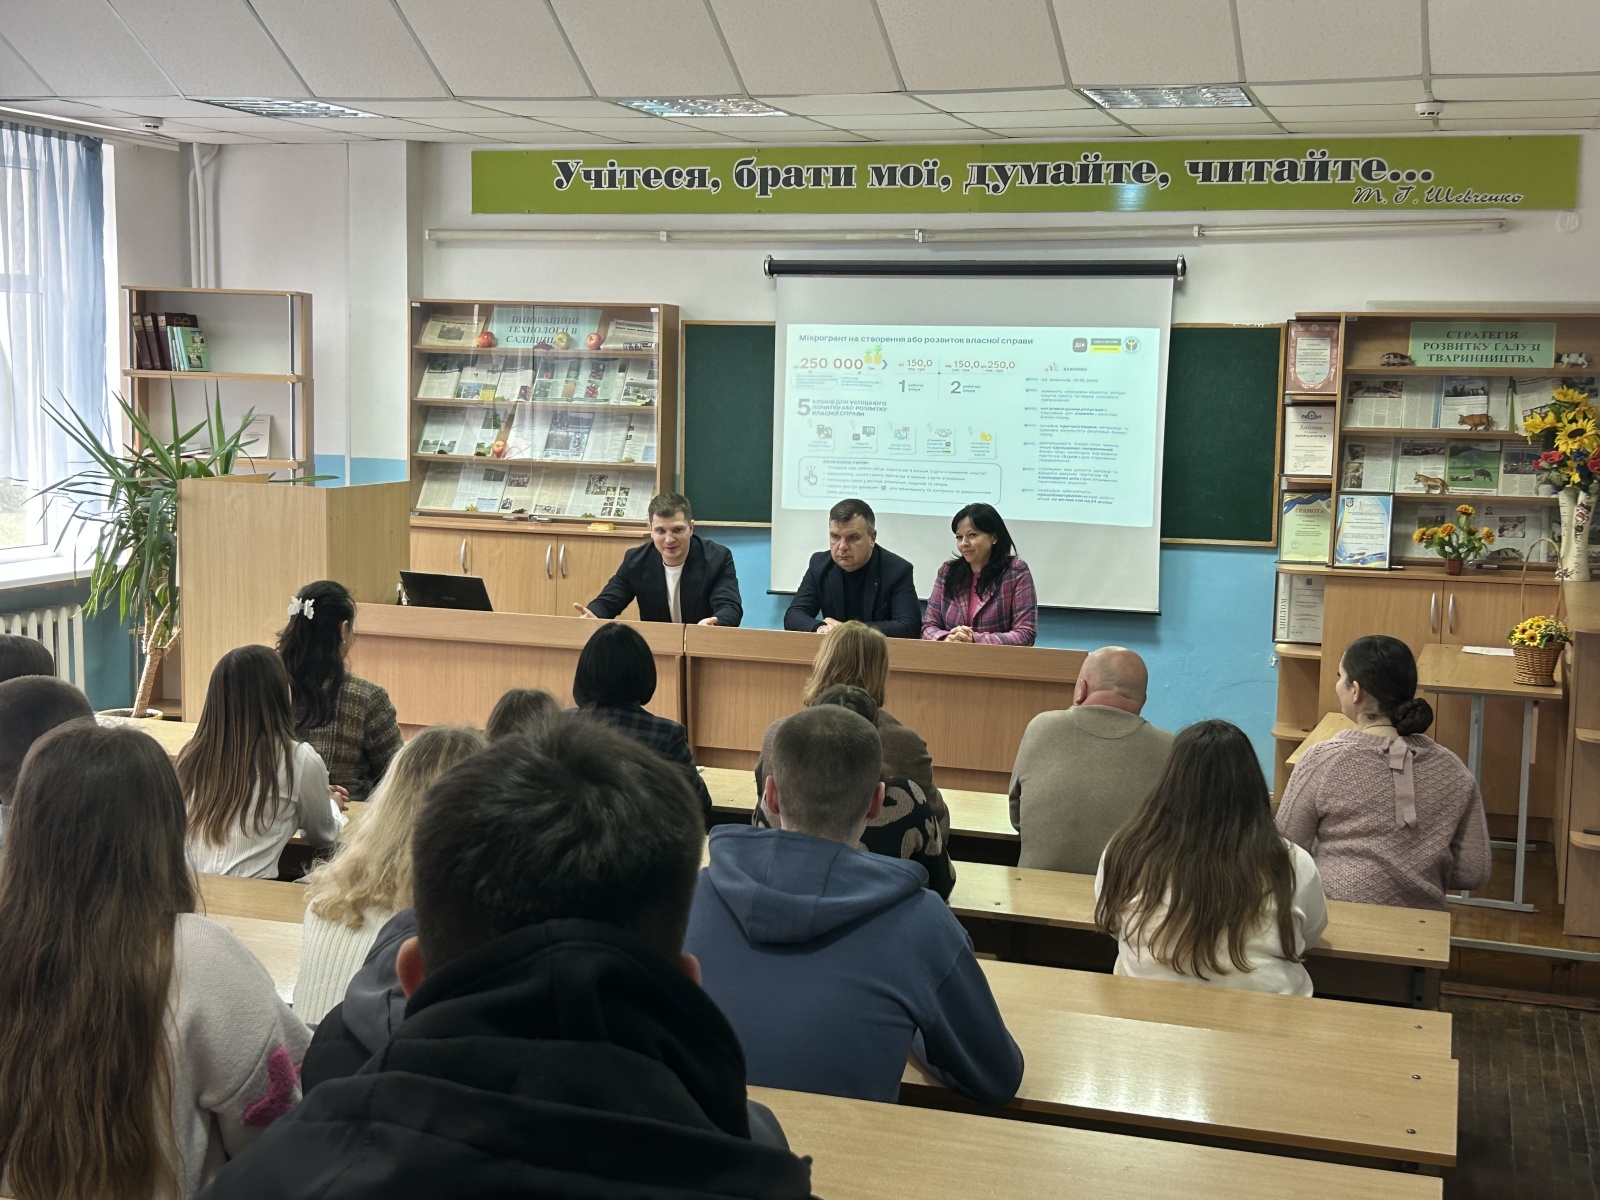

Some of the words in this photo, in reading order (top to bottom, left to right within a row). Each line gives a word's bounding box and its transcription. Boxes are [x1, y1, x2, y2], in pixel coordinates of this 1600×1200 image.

[552, 159, 722, 194] Учітеся,
[733, 157, 857, 198] брати
[868, 159, 952, 192] мої,
[963, 152, 1171, 195] думайте,
[1185, 149, 1434, 185] читайте...
[1424, 186, 1524, 204] Шевченко
[799, 334, 847, 342] Мікрогрант
[1446, 331, 1519, 339] СТРАТЕГІЯ
[1423, 342, 1491, 351] РОЗВИТКУ
[1494, 343, 1541, 351] ГАЛУЗІ
[1426, 353, 1535, 363] ТВАРИННИЦТВА
[800, 358, 828, 369] 250
[833, 358, 863, 369] 000
[907, 359, 933, 368] 150,0
[954, 360, 980, 369] 150,0
[987, 361, 1015, 370] 250,0
[898, 380, 905, 393] 1
[950, 380, 961, 394] 2
[797, 398, 811, 416] 5
